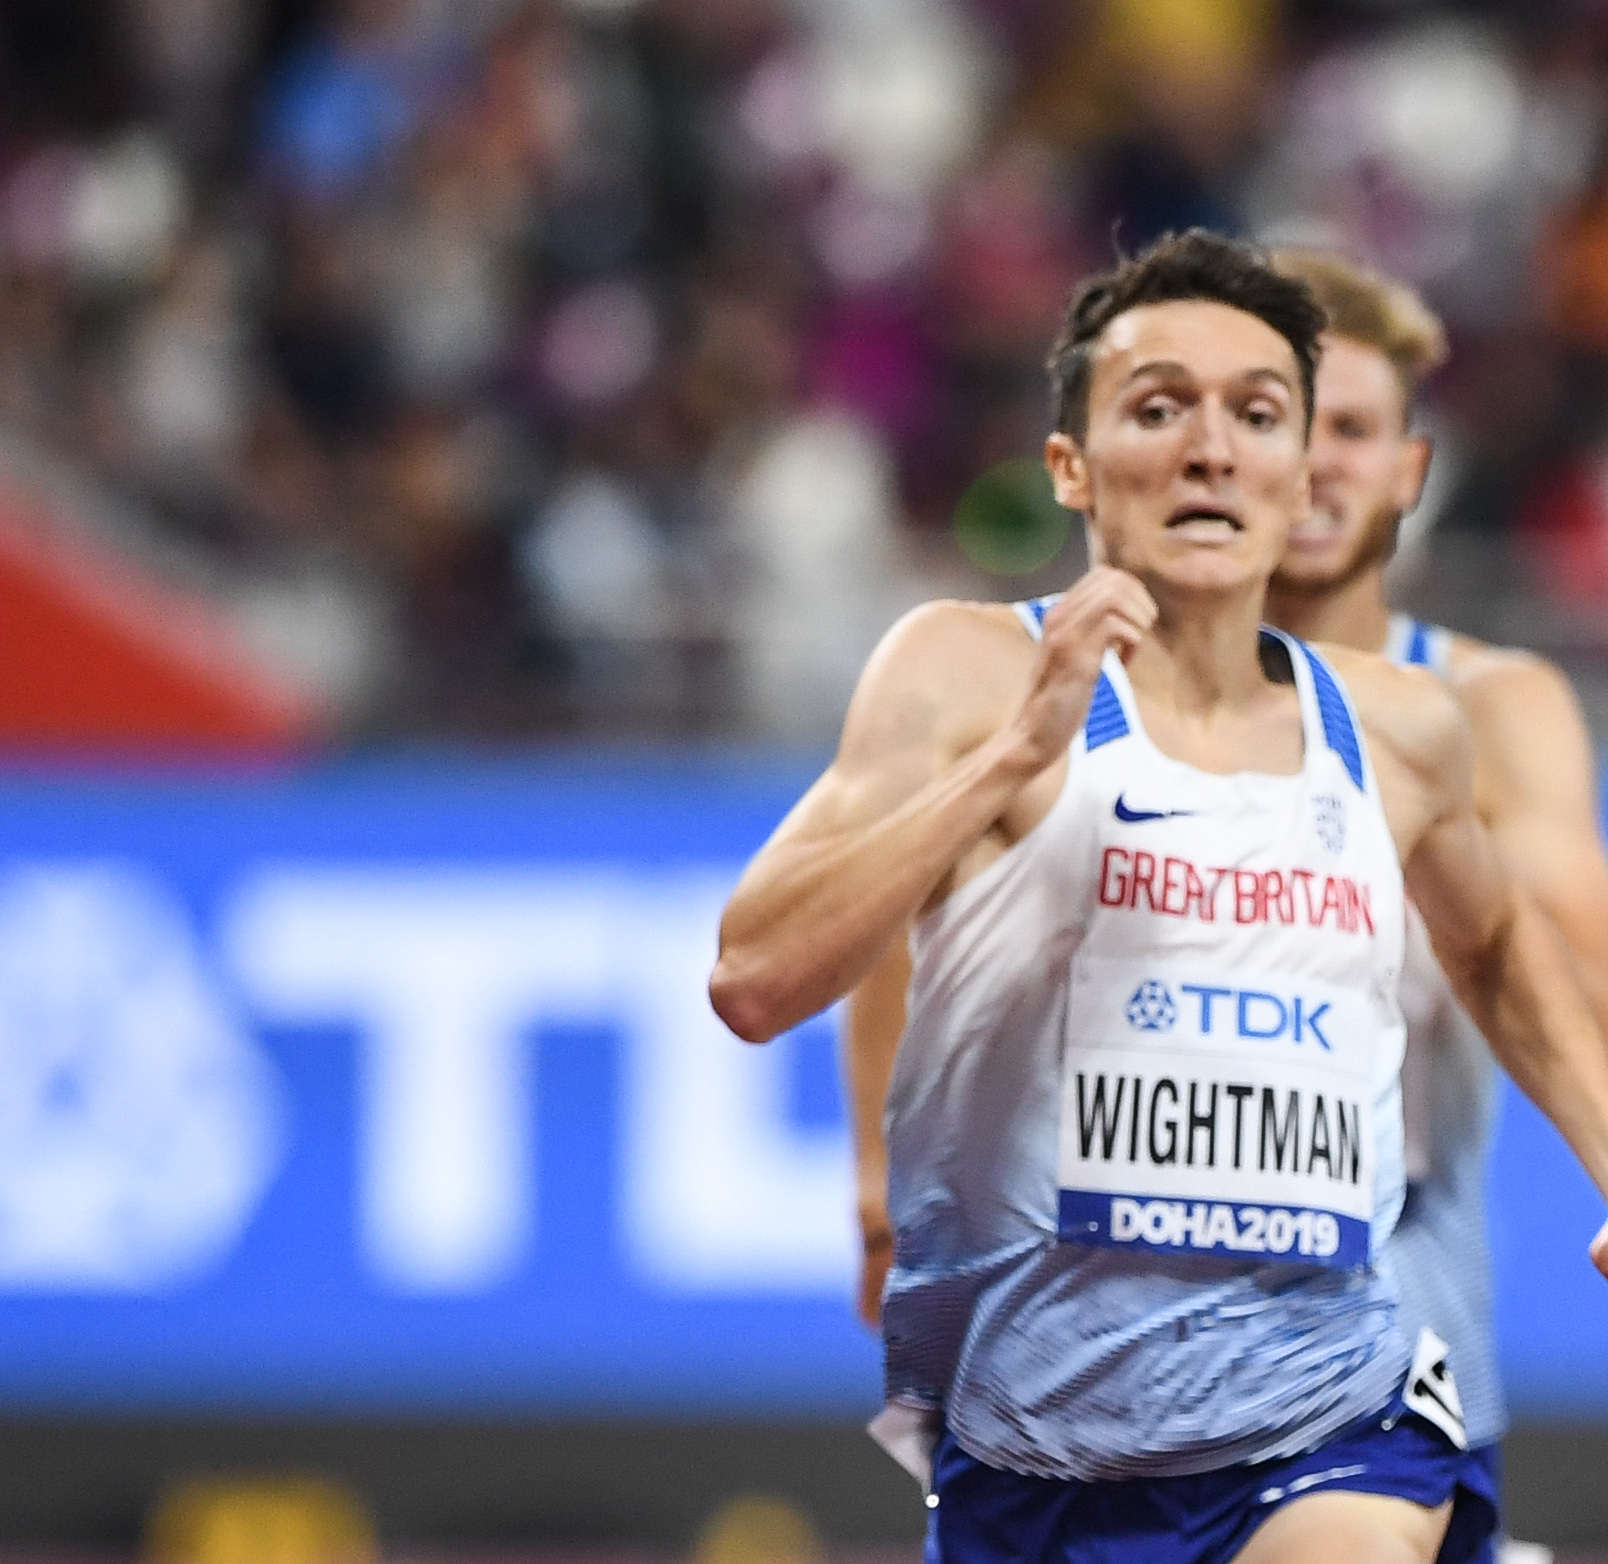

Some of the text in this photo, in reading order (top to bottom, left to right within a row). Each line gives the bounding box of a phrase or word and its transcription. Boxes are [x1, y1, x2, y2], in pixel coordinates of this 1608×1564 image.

[1181, 983, 1333, 1051] TDK
[1074, 1072, 1361, 1186] WIGHTMAN
[1110, 1196, 1341, 1258] DOHA2019
